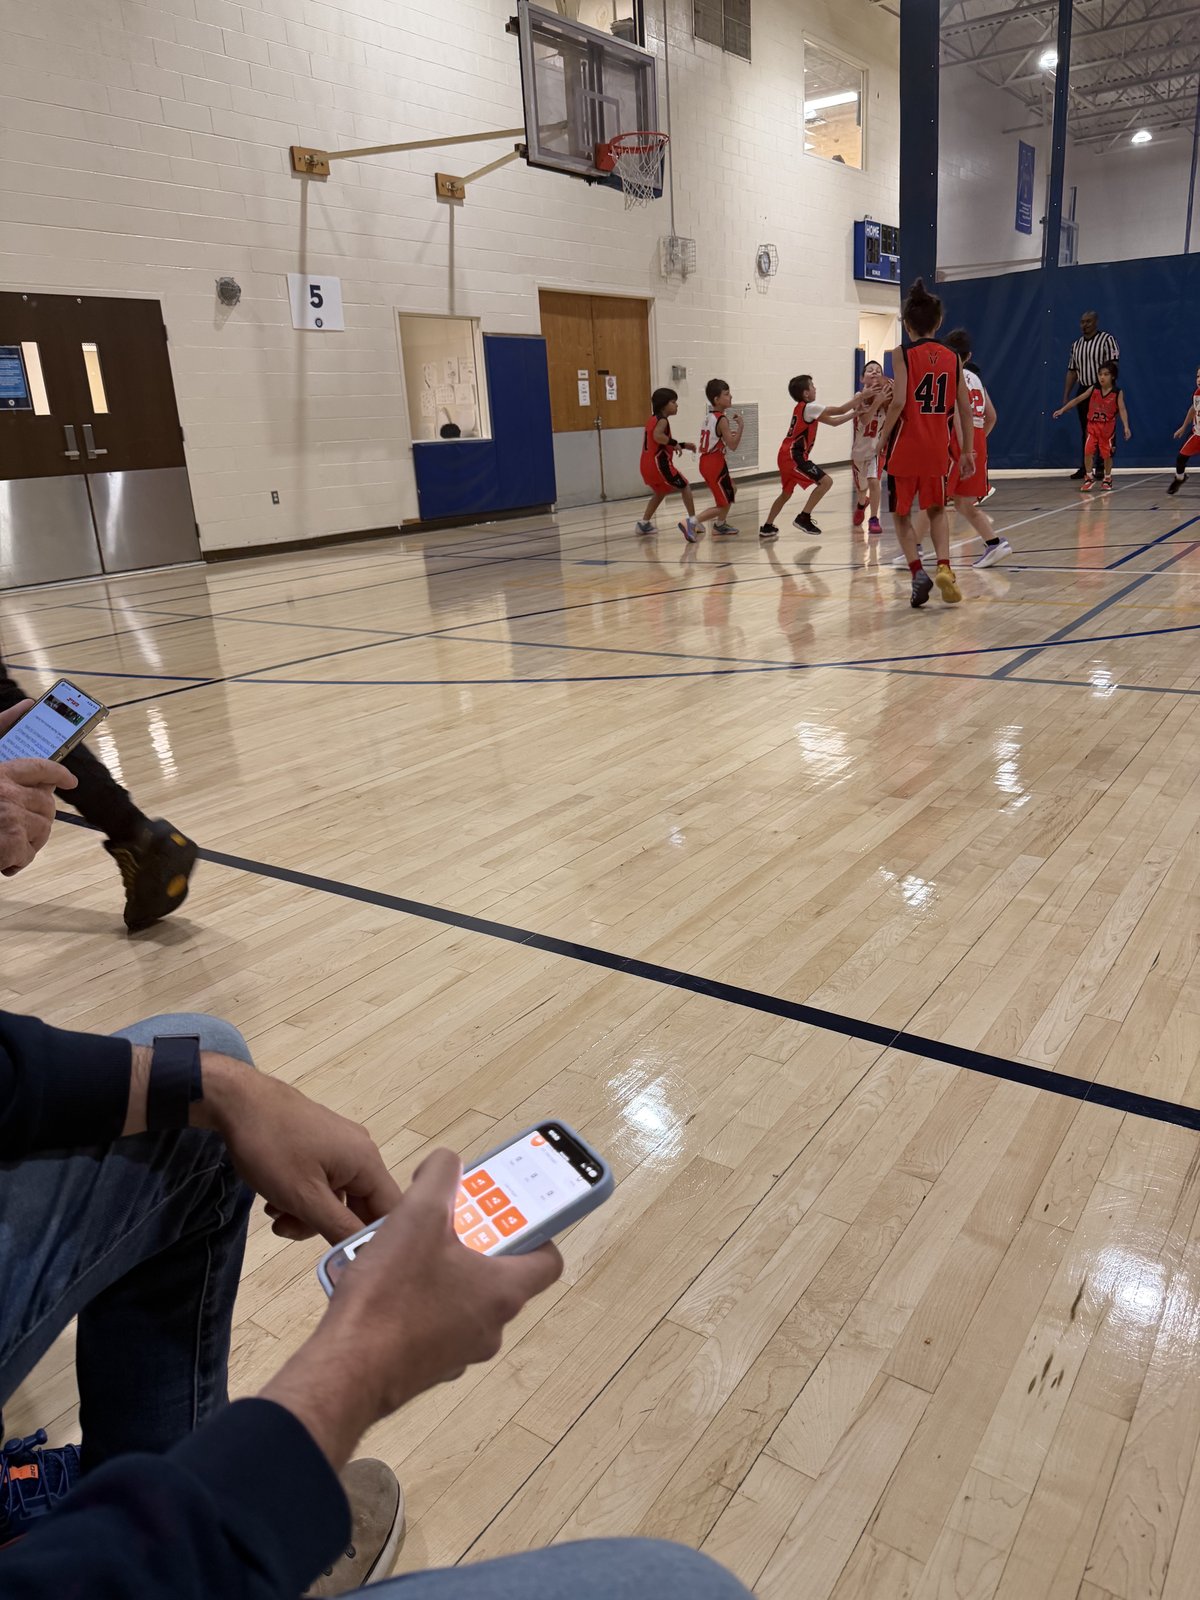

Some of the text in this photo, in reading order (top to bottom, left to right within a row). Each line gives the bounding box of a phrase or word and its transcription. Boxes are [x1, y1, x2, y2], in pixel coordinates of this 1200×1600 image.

[866, 225, 879, 237] HOME
[310, 284, 323, 308] 5
[915, 372, 948, 414] 41
